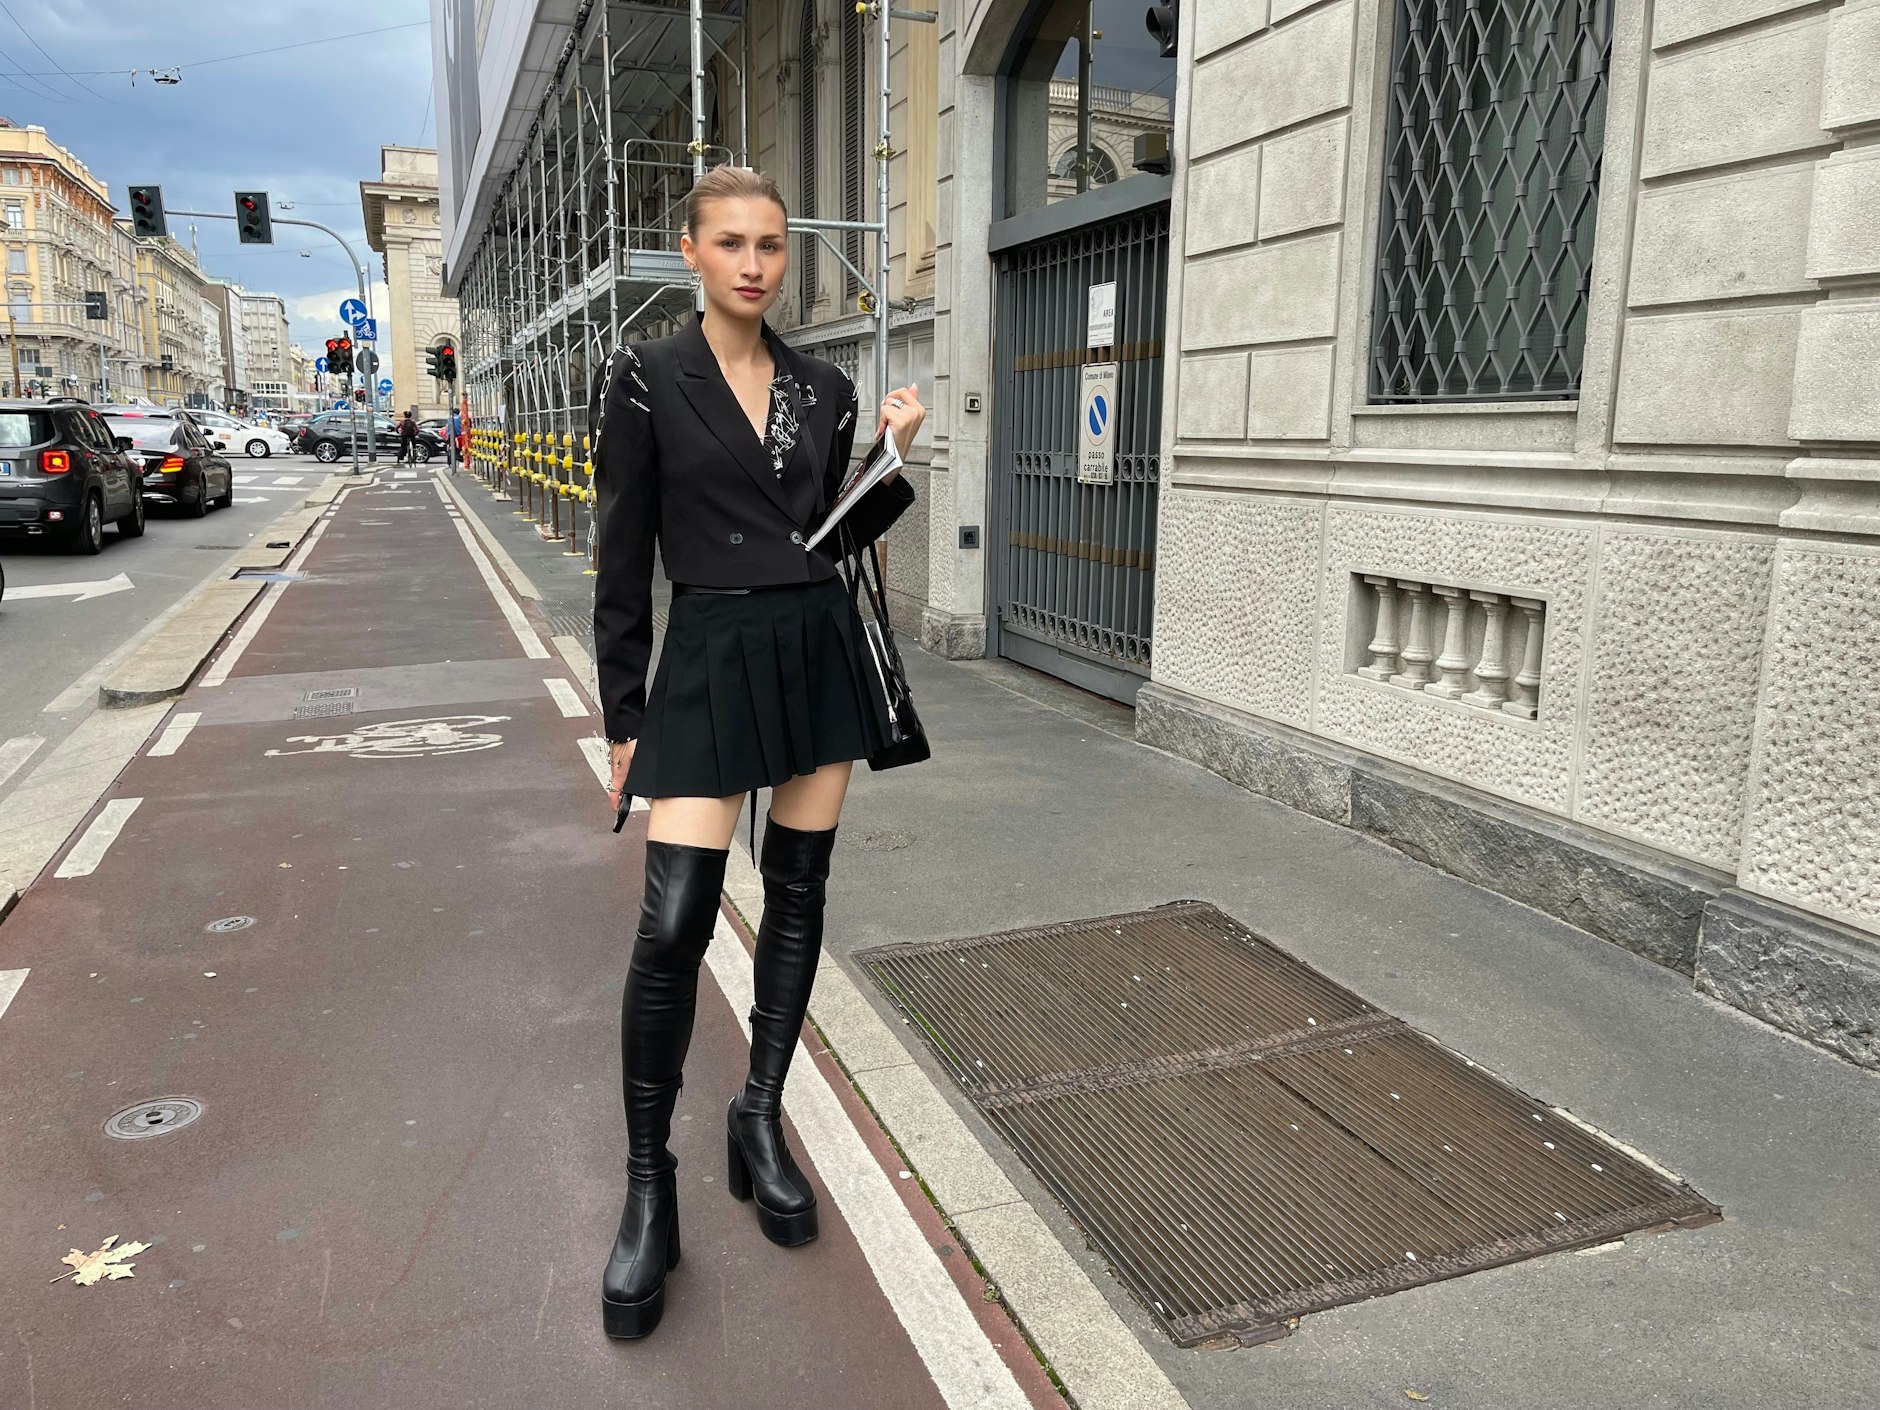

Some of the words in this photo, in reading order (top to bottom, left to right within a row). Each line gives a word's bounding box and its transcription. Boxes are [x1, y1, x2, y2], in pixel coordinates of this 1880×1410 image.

[1103, 308, 1114, 318] AREA
[1085, 372, 1098, 380] Comune
[1088, 451, 1104, 460] passo
[1084, 462, 1108, 472] carrabile
